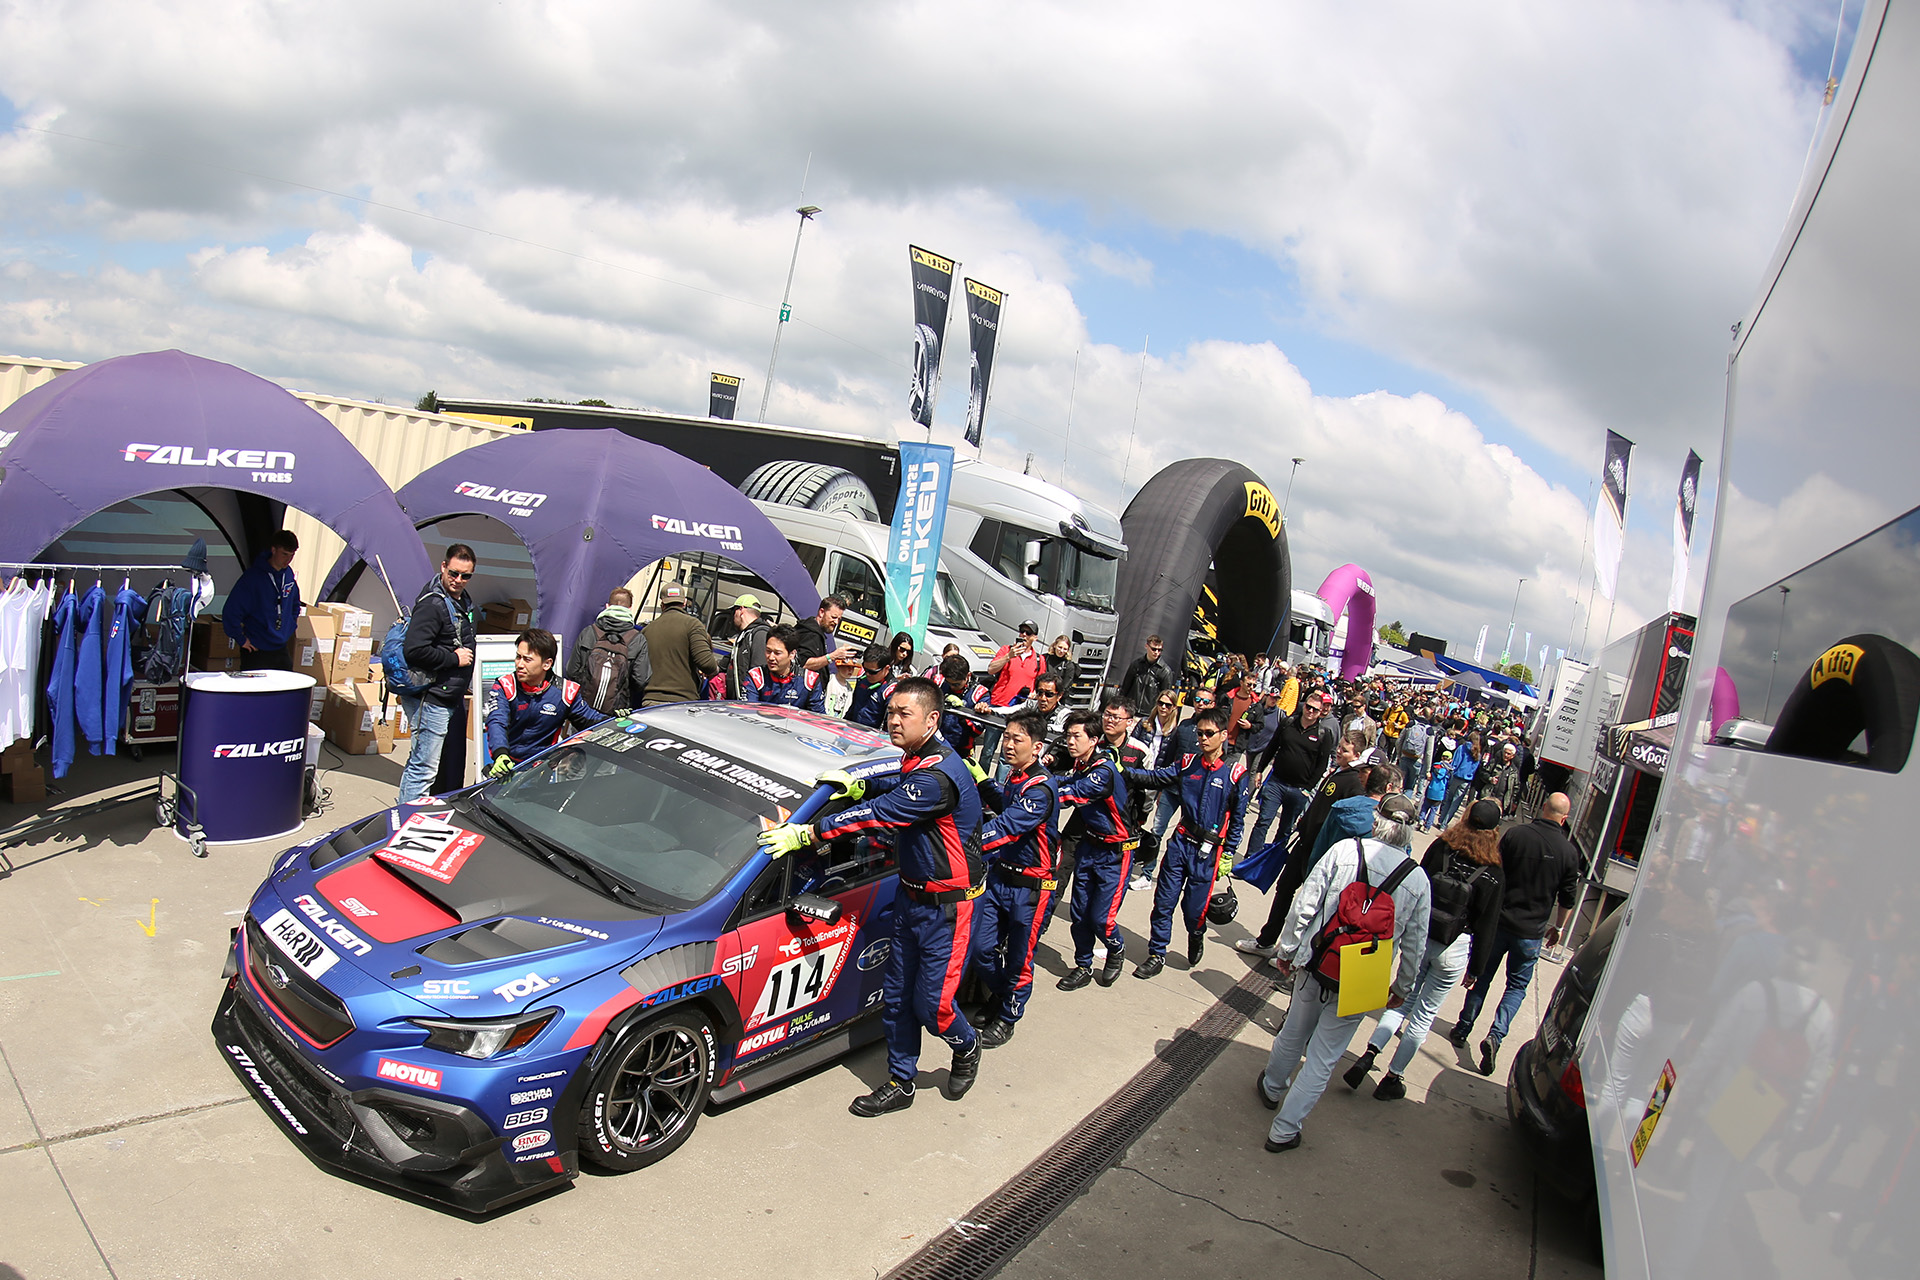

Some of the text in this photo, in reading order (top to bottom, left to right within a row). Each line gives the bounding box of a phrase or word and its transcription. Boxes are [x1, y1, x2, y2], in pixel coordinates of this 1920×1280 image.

[120, 443, 296, 470] FALKEN
[251, 471, 293, 484] TYRES
[453, 481, 548, 509] FALKEN
[1249, 489, 1272, 517] Giti
[508, 506, 535, 518] TYRES
[648, 514, 742, 541] FALKEN
[719, 541, 744, 551] TYRES
[842, 623, 863, 637] Giti
[1086, 648, 1103, 657] DAF
[210, 737, 305, 759] FALKEN
[284, 752, 303, 763] TYRES
[680, 749, 728, 771] GRAN
[676, 755, 780, 803] THE REAL DRIVING SIMULATOR
[377, 850, 452, 881] ADAC NORDRHEIN
[293, 894, 374, 957] FALKEN
[802, 925, 848, 948] TotalEnergies
[822, 914, 857, 997] ADAC NORDRHEIN
[422, 979, 471, 995] STC
[492, 971, 552, 1003] TOA
[640, 974, 722, 1009] FALKEN
[766, 954, 826, 1018] 114
[701, 1025, 717, 1083] FALKEN
[738, 1026, 785, 1055] MOTUL
[380, 1060, 440, 1088] MOTUL
[226, 1045, 255, 1068] STI
[244, 1066, 309, 1136] Performance
[505, 1109, 548, 1127] BBS
[594, 1092, 613, 1153] FALKEN
[517, 1133, 546, 1149] BMC
[515, 1150, 555, 1163] FUJITSUBO
